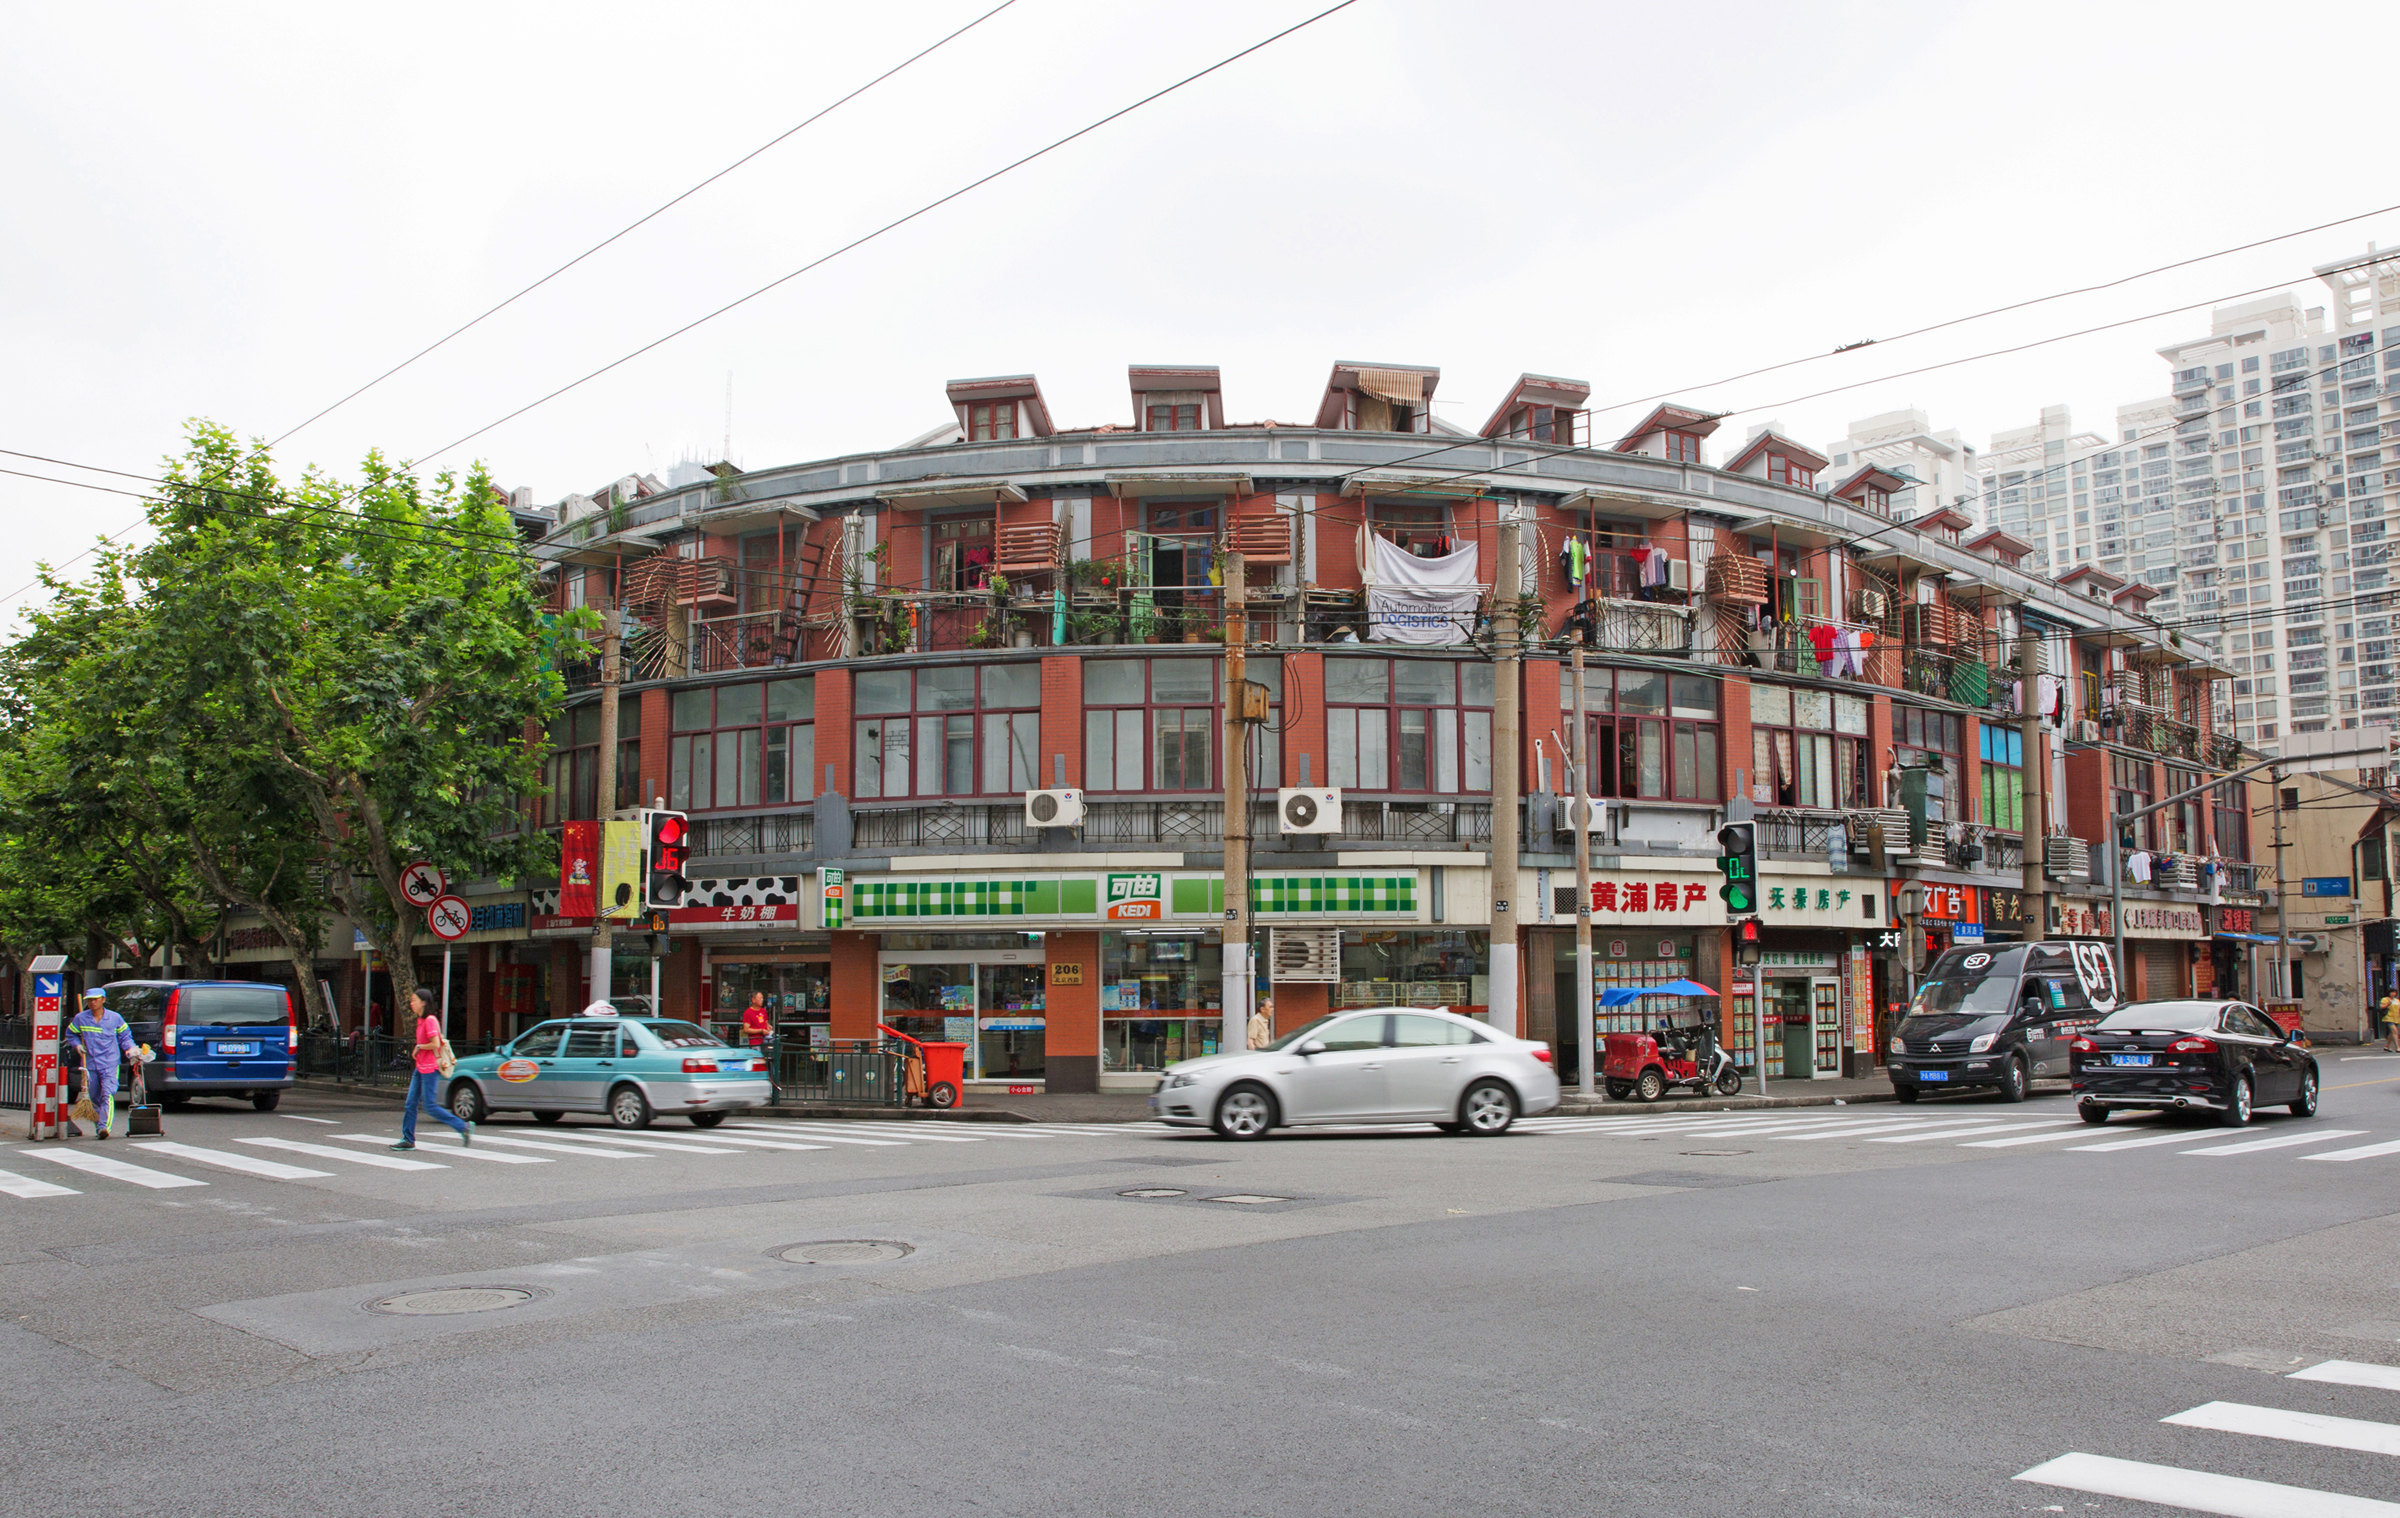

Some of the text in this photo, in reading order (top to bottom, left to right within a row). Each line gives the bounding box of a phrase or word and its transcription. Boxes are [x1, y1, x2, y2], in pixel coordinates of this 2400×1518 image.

[1382, 600, 1448, 613] Automotive
[1381, 613, 1449, 628] LOGISTICS
[1111, 875, 1158, 899] 可的
[1590, 882, 1706, 913] 黄浦房产
[1769, 887, 1851, 910] 天景房产
[721, 906, 777, 920] 牛奶棚
[1118, 905, 1151, 917] KEDI
[1055, 965, 1078, 974] 206
[2079, 945, 2106, 989] SF
